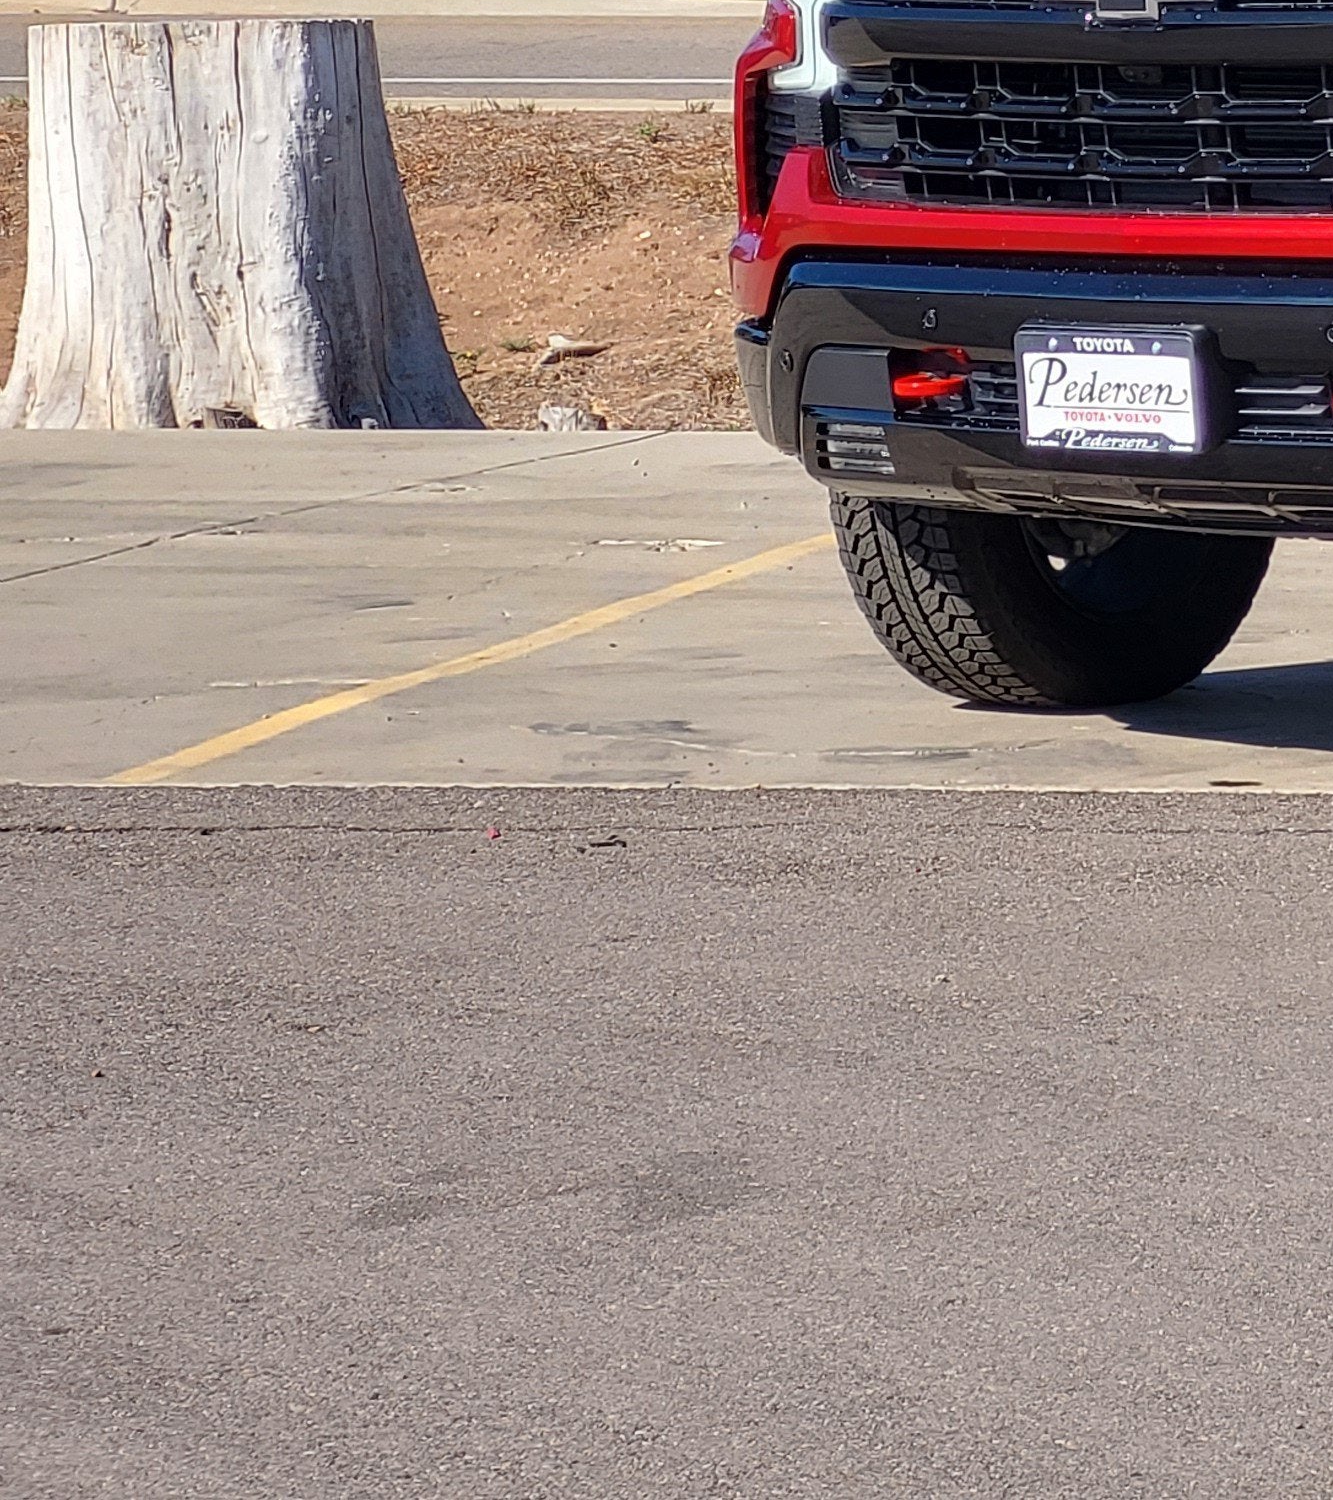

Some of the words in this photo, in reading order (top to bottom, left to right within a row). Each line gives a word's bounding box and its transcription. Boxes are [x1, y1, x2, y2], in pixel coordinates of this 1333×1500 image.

[1072, 337, 1135, 353] TOYOTA
[1029, 357, 1188, 407] Pedersen
[1064, 411, 1106, 422] TOYOTA
[1114, 412, 1161, 424] VOLVO
[1061, 427, 1159, 451] Pedersen
